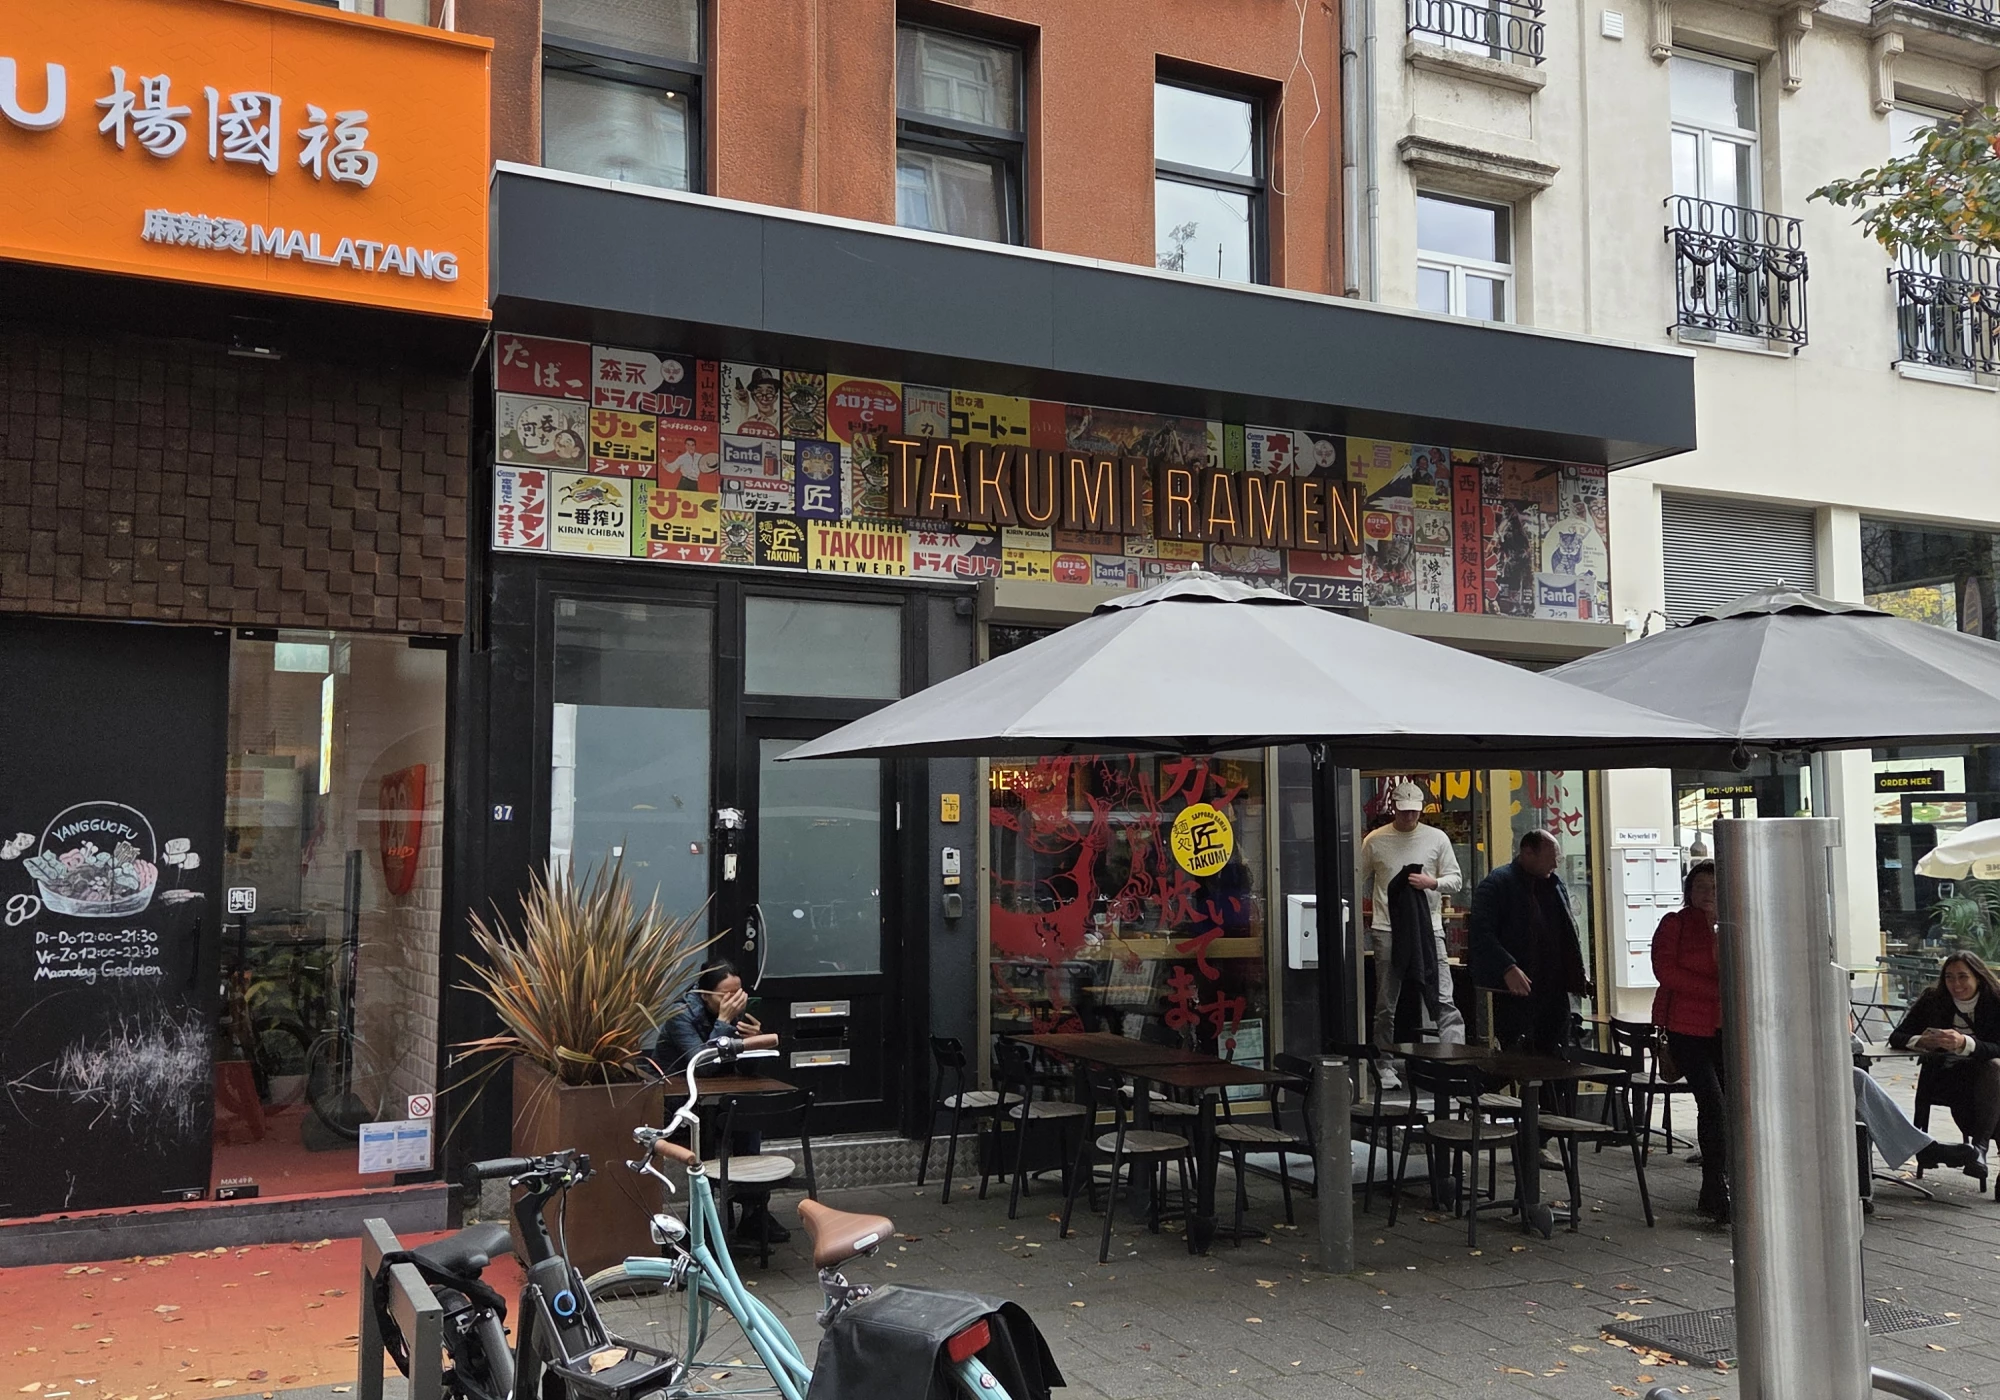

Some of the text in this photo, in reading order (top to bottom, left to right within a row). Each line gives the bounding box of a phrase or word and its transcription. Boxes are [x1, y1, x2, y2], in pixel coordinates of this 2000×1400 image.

[95, 66, 379, 188] 楊國福
[251, 224, 458, 281] MALATANG
[600, 359, 647, 385] 森永
[594, 386, 692, 417] ドライミルク
[860, 410, 874, 422] C
[593, 441, 655, 462] ピジョン
[725, 446, 761, 461] Fanta
[594, 458, 653, 478] シャツ
[745, 480, 789, 492] SANYO
[878, 434, 1366, 553] TAKUMI RAMEN
[802, 484, 835, 513] 匠
[557, 508, 624, 527] 一番搾り
[557, 525, 624, 538] KIRIN ICHIBAN
[651, 522, 717, 545] ピジョン
[651, 543, 715, 562] シャツ
[818, 530, 903, 563] TAKUMI
[815, 559, 906, 576] ANTWERP
[913, 552, 1003, 577] ドライミルク
[1096, 565, 1124, 578] Fanta
[1541, 586, 1575, 604] Fanta
[1880, 776, 1932, 788] ORDER HERE
[494, 805, 513, 821] 37
[1190, 820, 1224, 856] 匠
[34, 960, 163, 985] Maandag Gesloten
[220, 1178, 238, 1186] MAX
